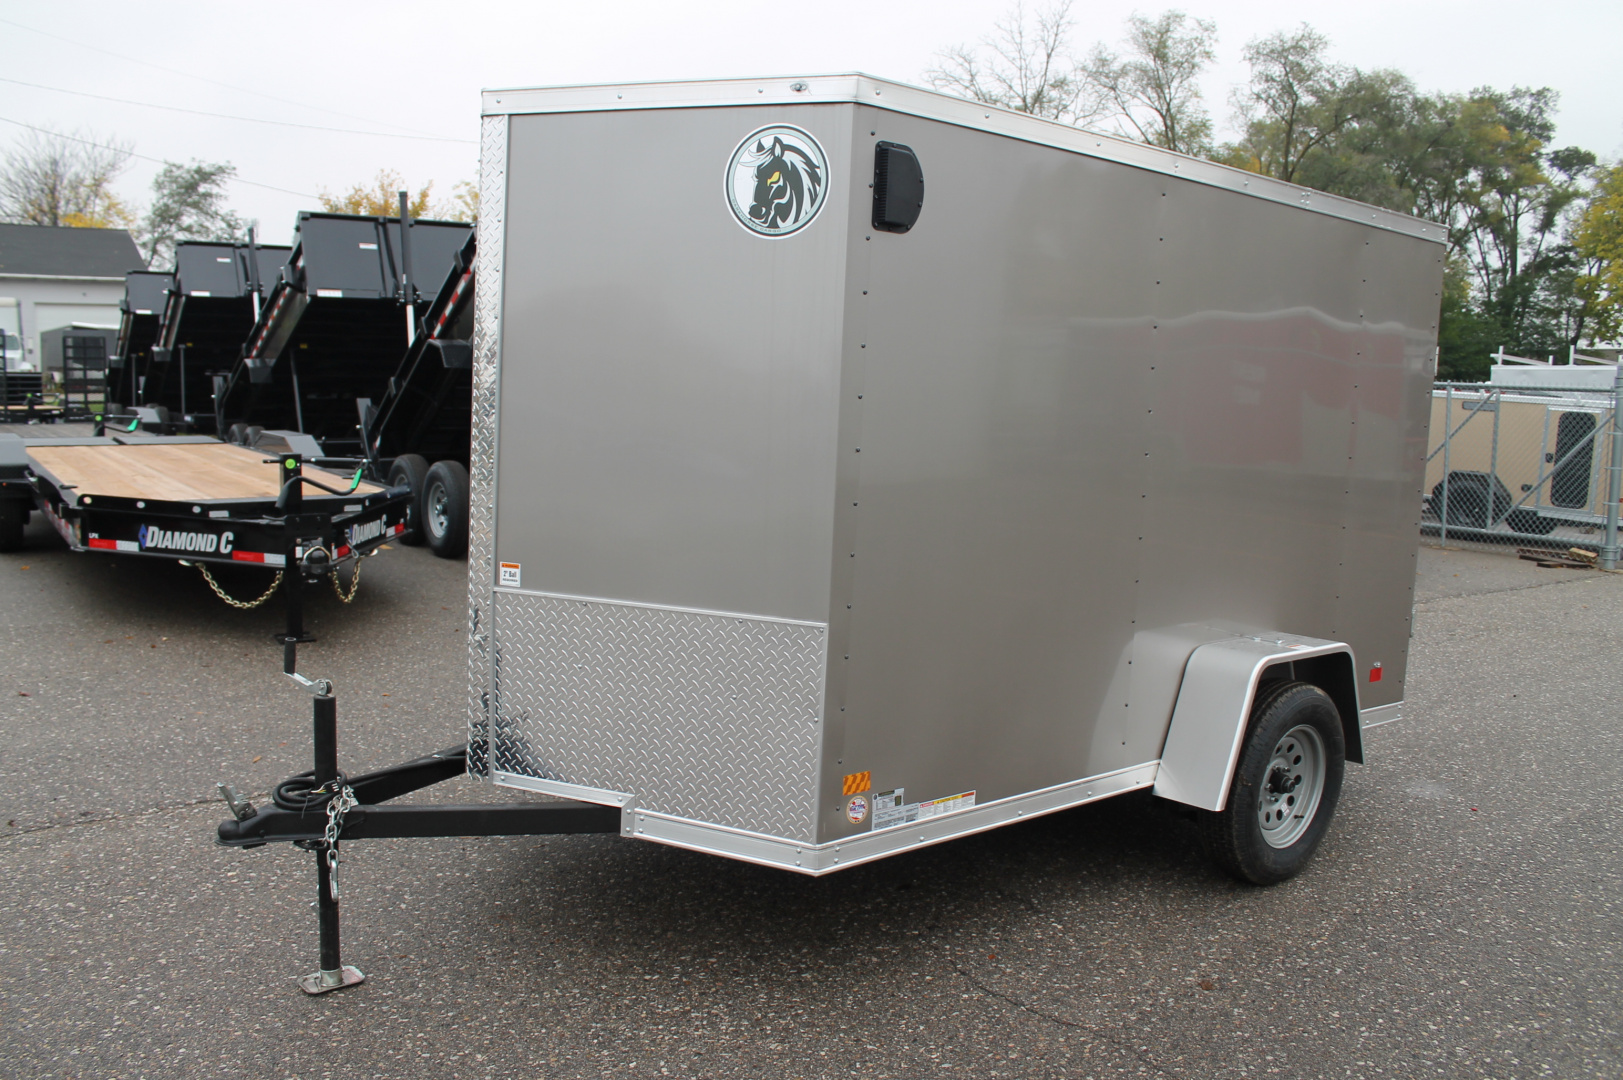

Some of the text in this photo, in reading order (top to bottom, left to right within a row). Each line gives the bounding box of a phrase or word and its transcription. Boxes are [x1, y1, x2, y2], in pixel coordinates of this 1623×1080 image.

[146, 526, 234, 553] DIAMOND C
[352, 514, 386, 545] DIAMOND C
